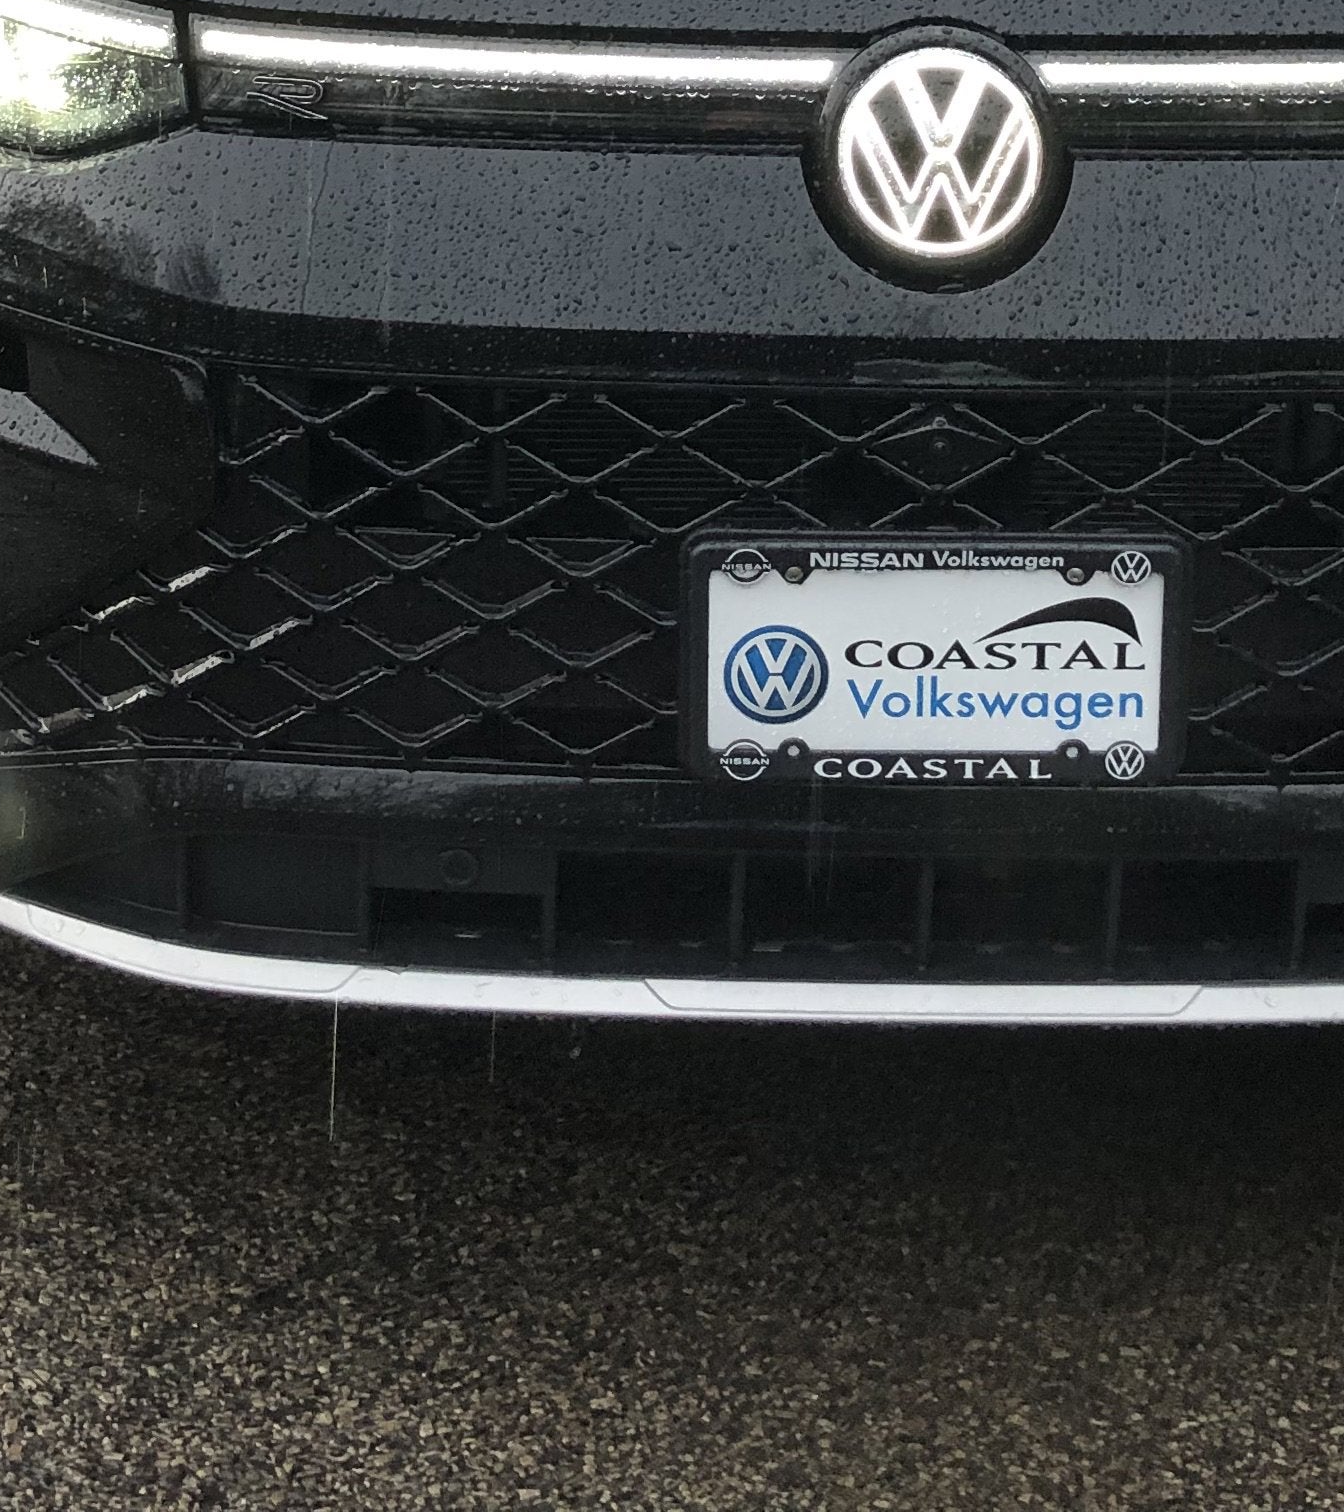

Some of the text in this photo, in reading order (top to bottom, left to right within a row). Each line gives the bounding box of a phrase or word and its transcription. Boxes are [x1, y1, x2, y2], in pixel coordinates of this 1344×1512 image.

[838, 46, 1043, 256] VW
[722, 563, 771, 571] NISSAN
[809, 551, 1065, 569] NISSAN Volkswagen
[1112, 551, 1151, 585] VW
[844, 640, 1145, 670] COASTAL
[724, 625, 829, 724] VW
[846, 676, 1144, 730] Volkswagen
[720, 757, 770, 766] NISSAN
[813, 757, 1052, 779] COASTAL
[1105, 743, 1145, 780] VW
